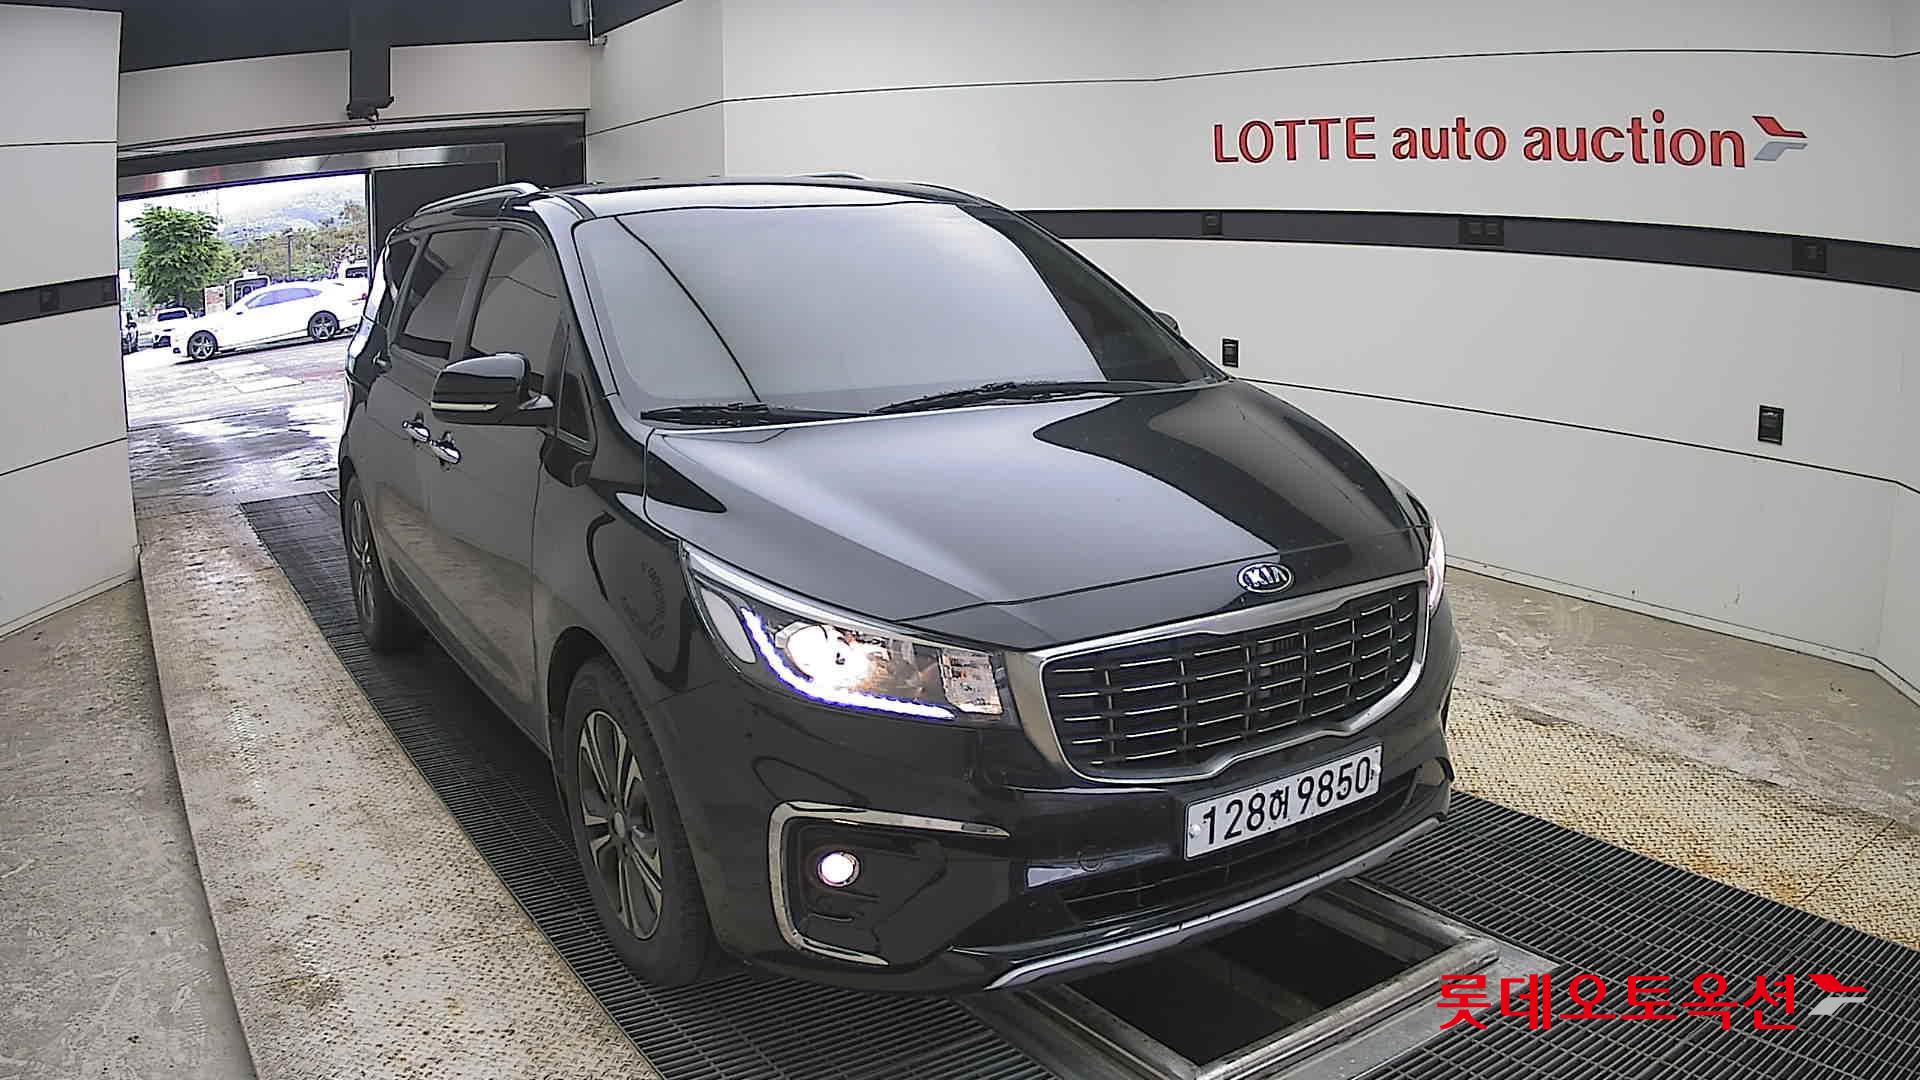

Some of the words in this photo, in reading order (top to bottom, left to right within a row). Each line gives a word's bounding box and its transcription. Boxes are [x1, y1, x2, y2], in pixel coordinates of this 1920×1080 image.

[1213, 116, 1376, 164] LOTTE
[1391, 116, 1508, 161] auto
[1521, 109, 1747, 168] auction
[1245, 565, 1288, 587] KIA
[1203, 785, 1290, 845] 128허
[1297, 756, 1371, 815] 9850
